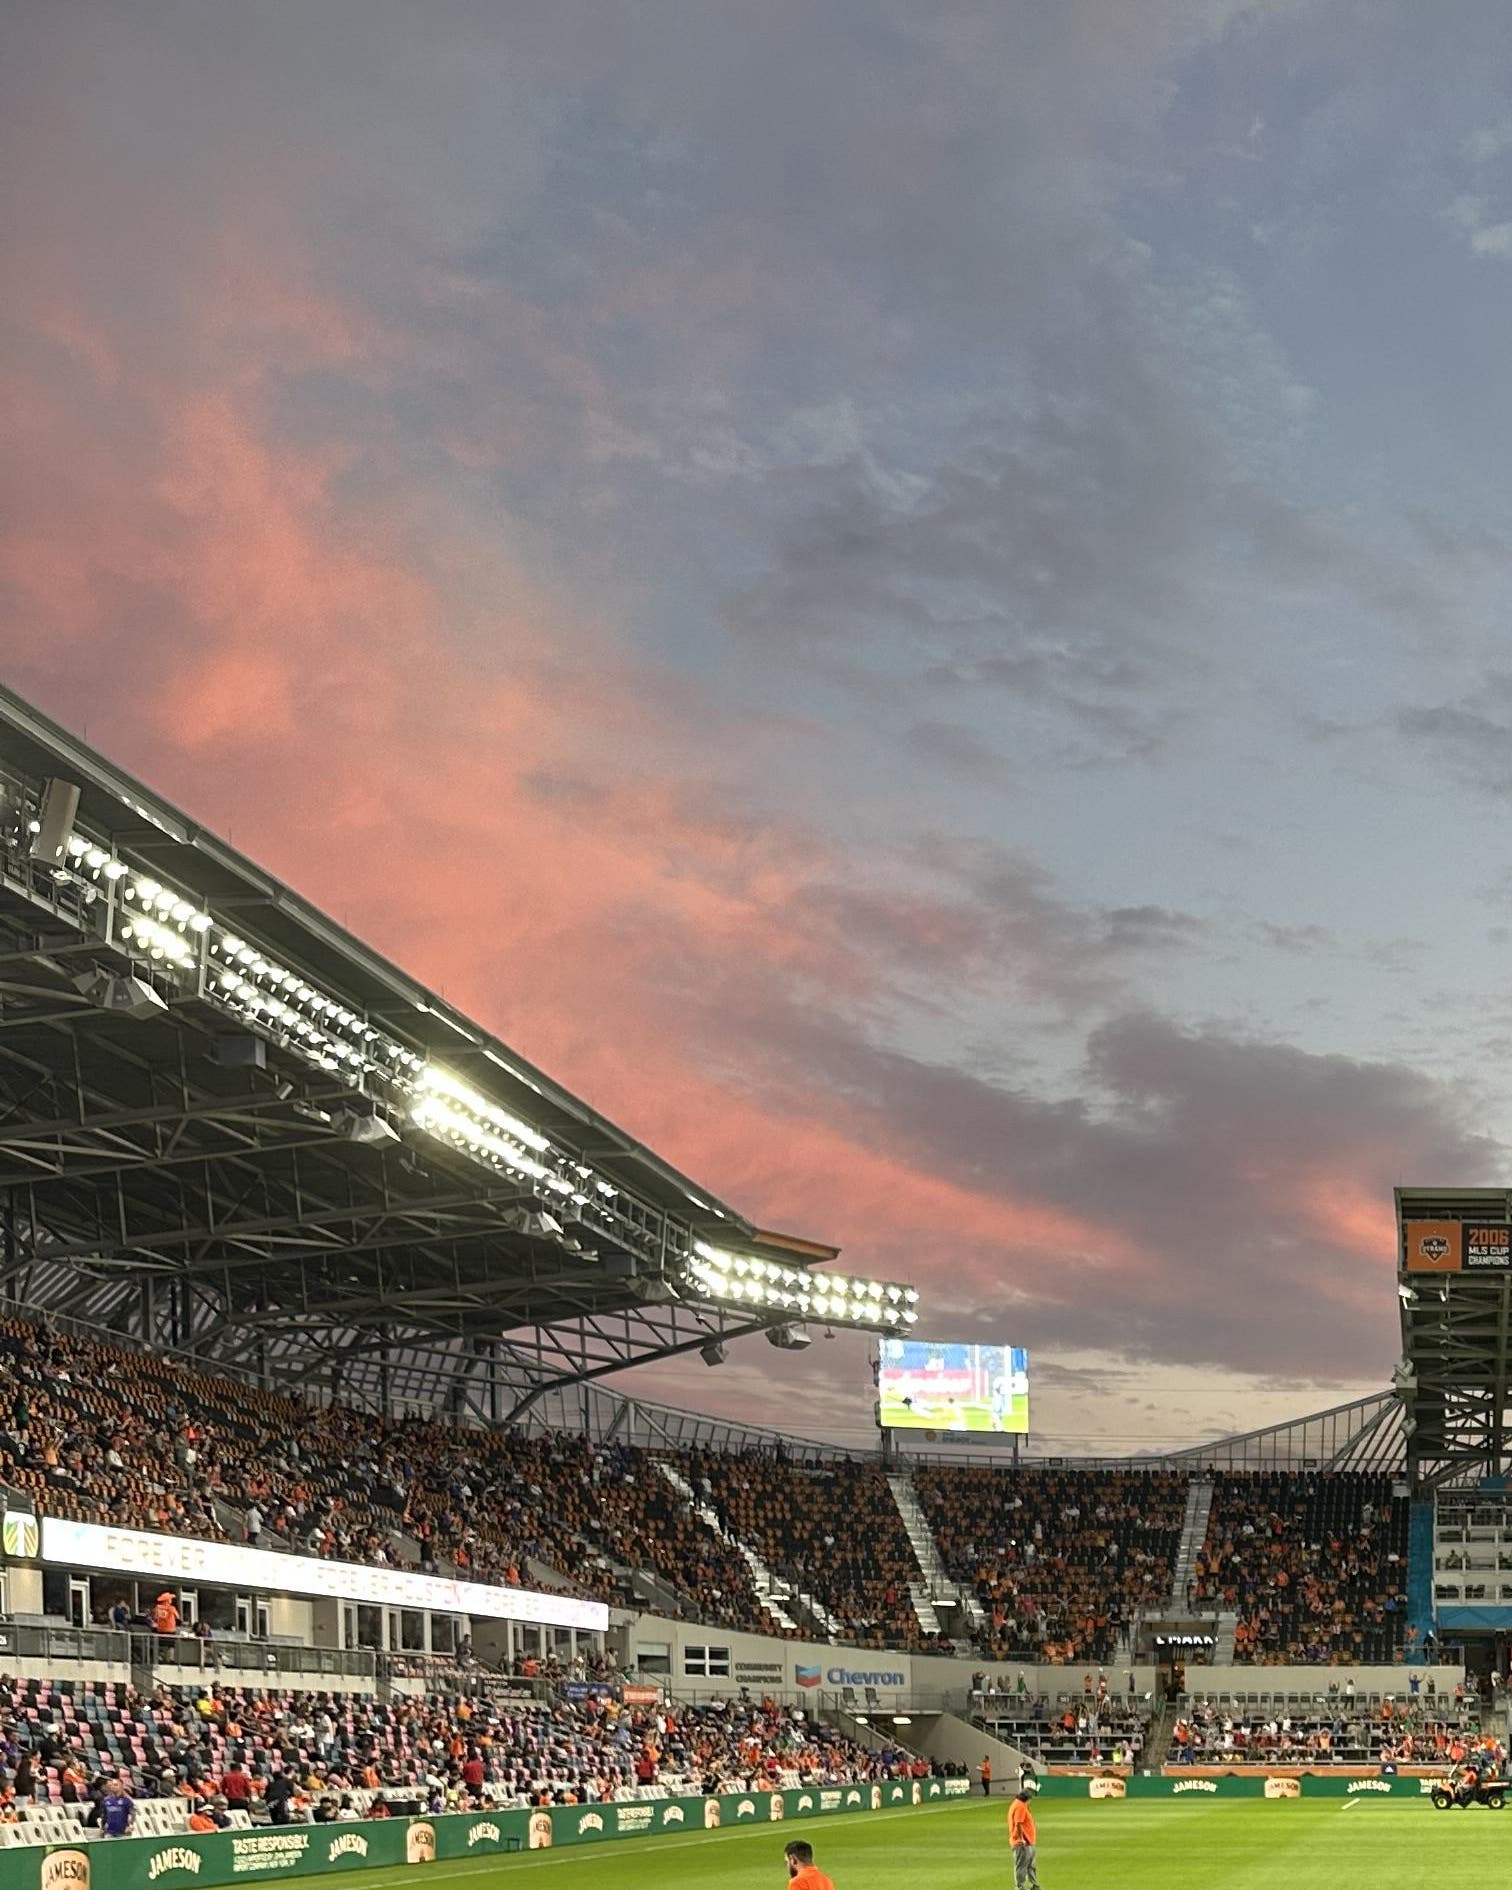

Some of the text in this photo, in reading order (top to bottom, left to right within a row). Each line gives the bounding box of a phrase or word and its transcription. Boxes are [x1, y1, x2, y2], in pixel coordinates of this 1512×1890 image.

[1469, 1229, 1509, 1245] 2006
[1468, 1246, 1509, 1255] MLS CUP
[1468, 1256, 1510, 1266] CHAMPIONS
[827, 1668, 905, 1686] Chevron
[1173, 1780, 1218, 1793] JAMESON
[1347, 1779, 1392, 1793] JAMESON
[233, 1837, 257, 1855] TASTE
[329, 1833, 369, 1862] JAMESON
[149, 1847, 202, 1880] JAMESON
